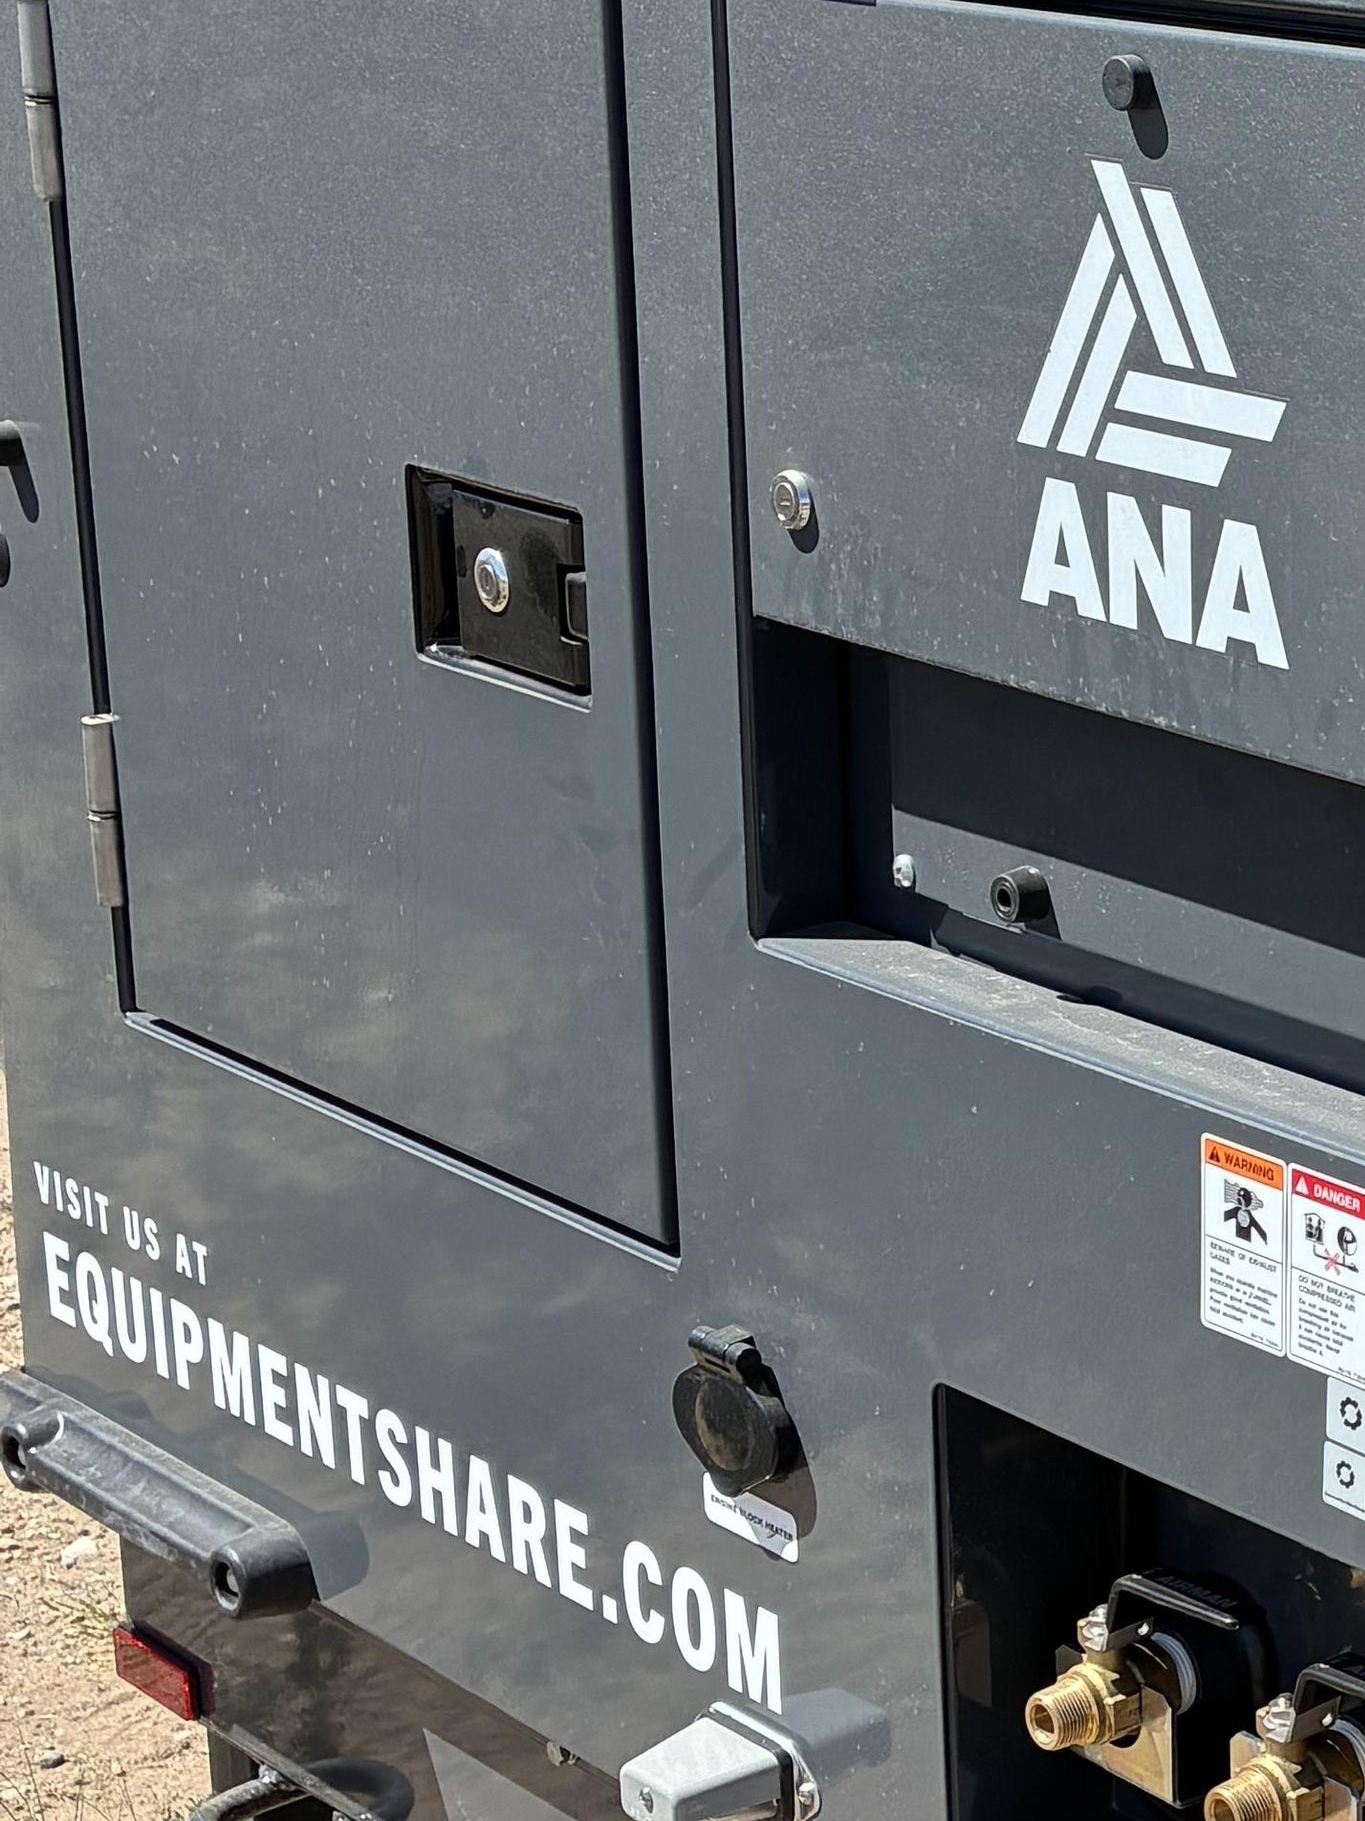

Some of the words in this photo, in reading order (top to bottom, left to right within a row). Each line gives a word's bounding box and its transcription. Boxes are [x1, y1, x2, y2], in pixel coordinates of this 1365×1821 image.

[1020, 477, 1290, 670] ANA
[33, 1161, 110, 1236] VISIT
[123, 1205, 161, 1261] US
[175, 1240, 209, 1285] AT
[1223, 1151, 1275, 1181] WARNING
[1314, 1183, 1361, 1213] DANGER
[42, 1229, 784, 1715] EQUIPMENTSHARE.COM
